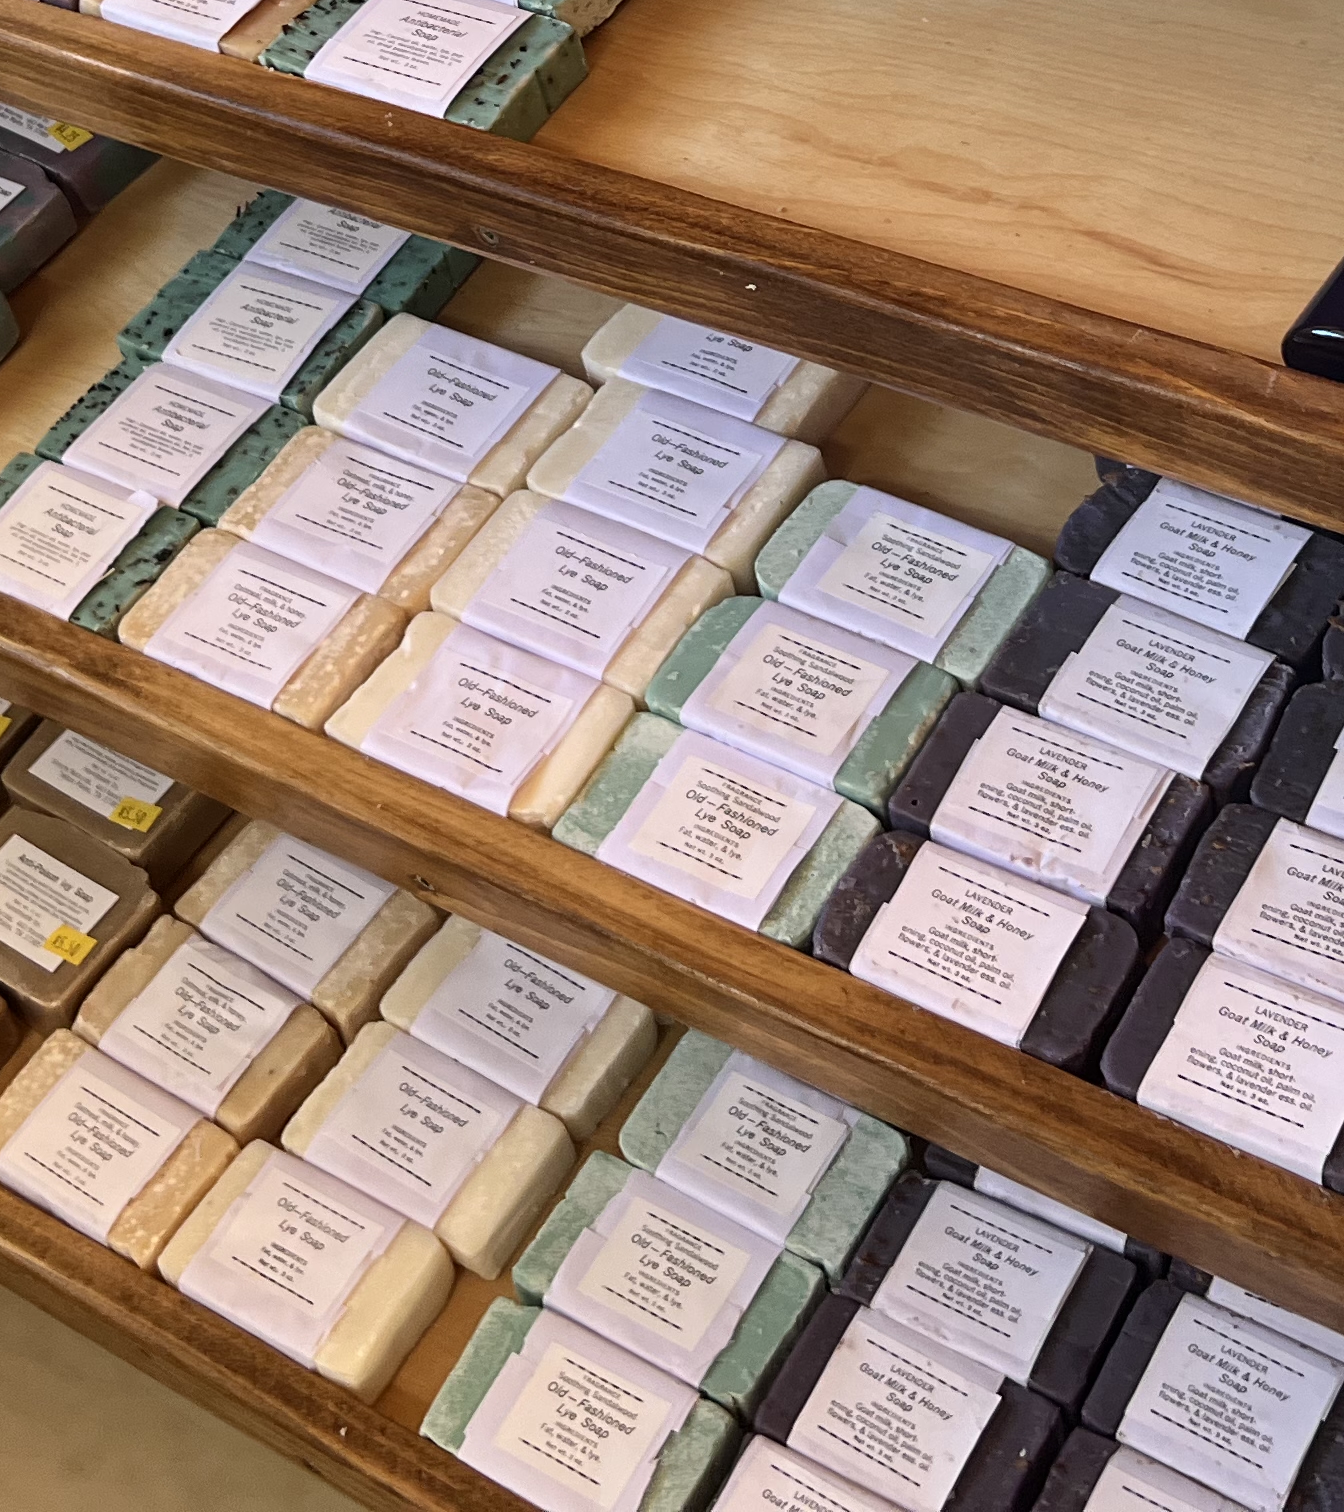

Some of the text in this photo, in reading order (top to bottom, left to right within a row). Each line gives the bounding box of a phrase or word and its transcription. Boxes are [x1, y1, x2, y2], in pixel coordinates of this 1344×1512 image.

[399, 15, 468, 38] Antibacterial
[411, 28, 439, 41] Soap
[460, 696, 512, 725] Lye Soap
[695, 808, 751, 840] Lye Soap
[1287, 866, 1318, 883] Goat
[1318, 877, 1344, 892] Milk
[931, 888, 1035, 941] Goat Milk & Honey
[965, 889, 1014, 916] LAVENDER
[1290, 903, 1313, 917] Goat
[961, 915, 991, 935] Soap
[1293, 914, 1332, 933] coconut
[1218, 1006, 1333, 1058] Goat Milk & Honey
[1255, 1006, 1308, 1032] LAVENDER
[1254, 1034, 1286, 1053] Soap
[278, 1219, 325, 1250] Lye Soap
